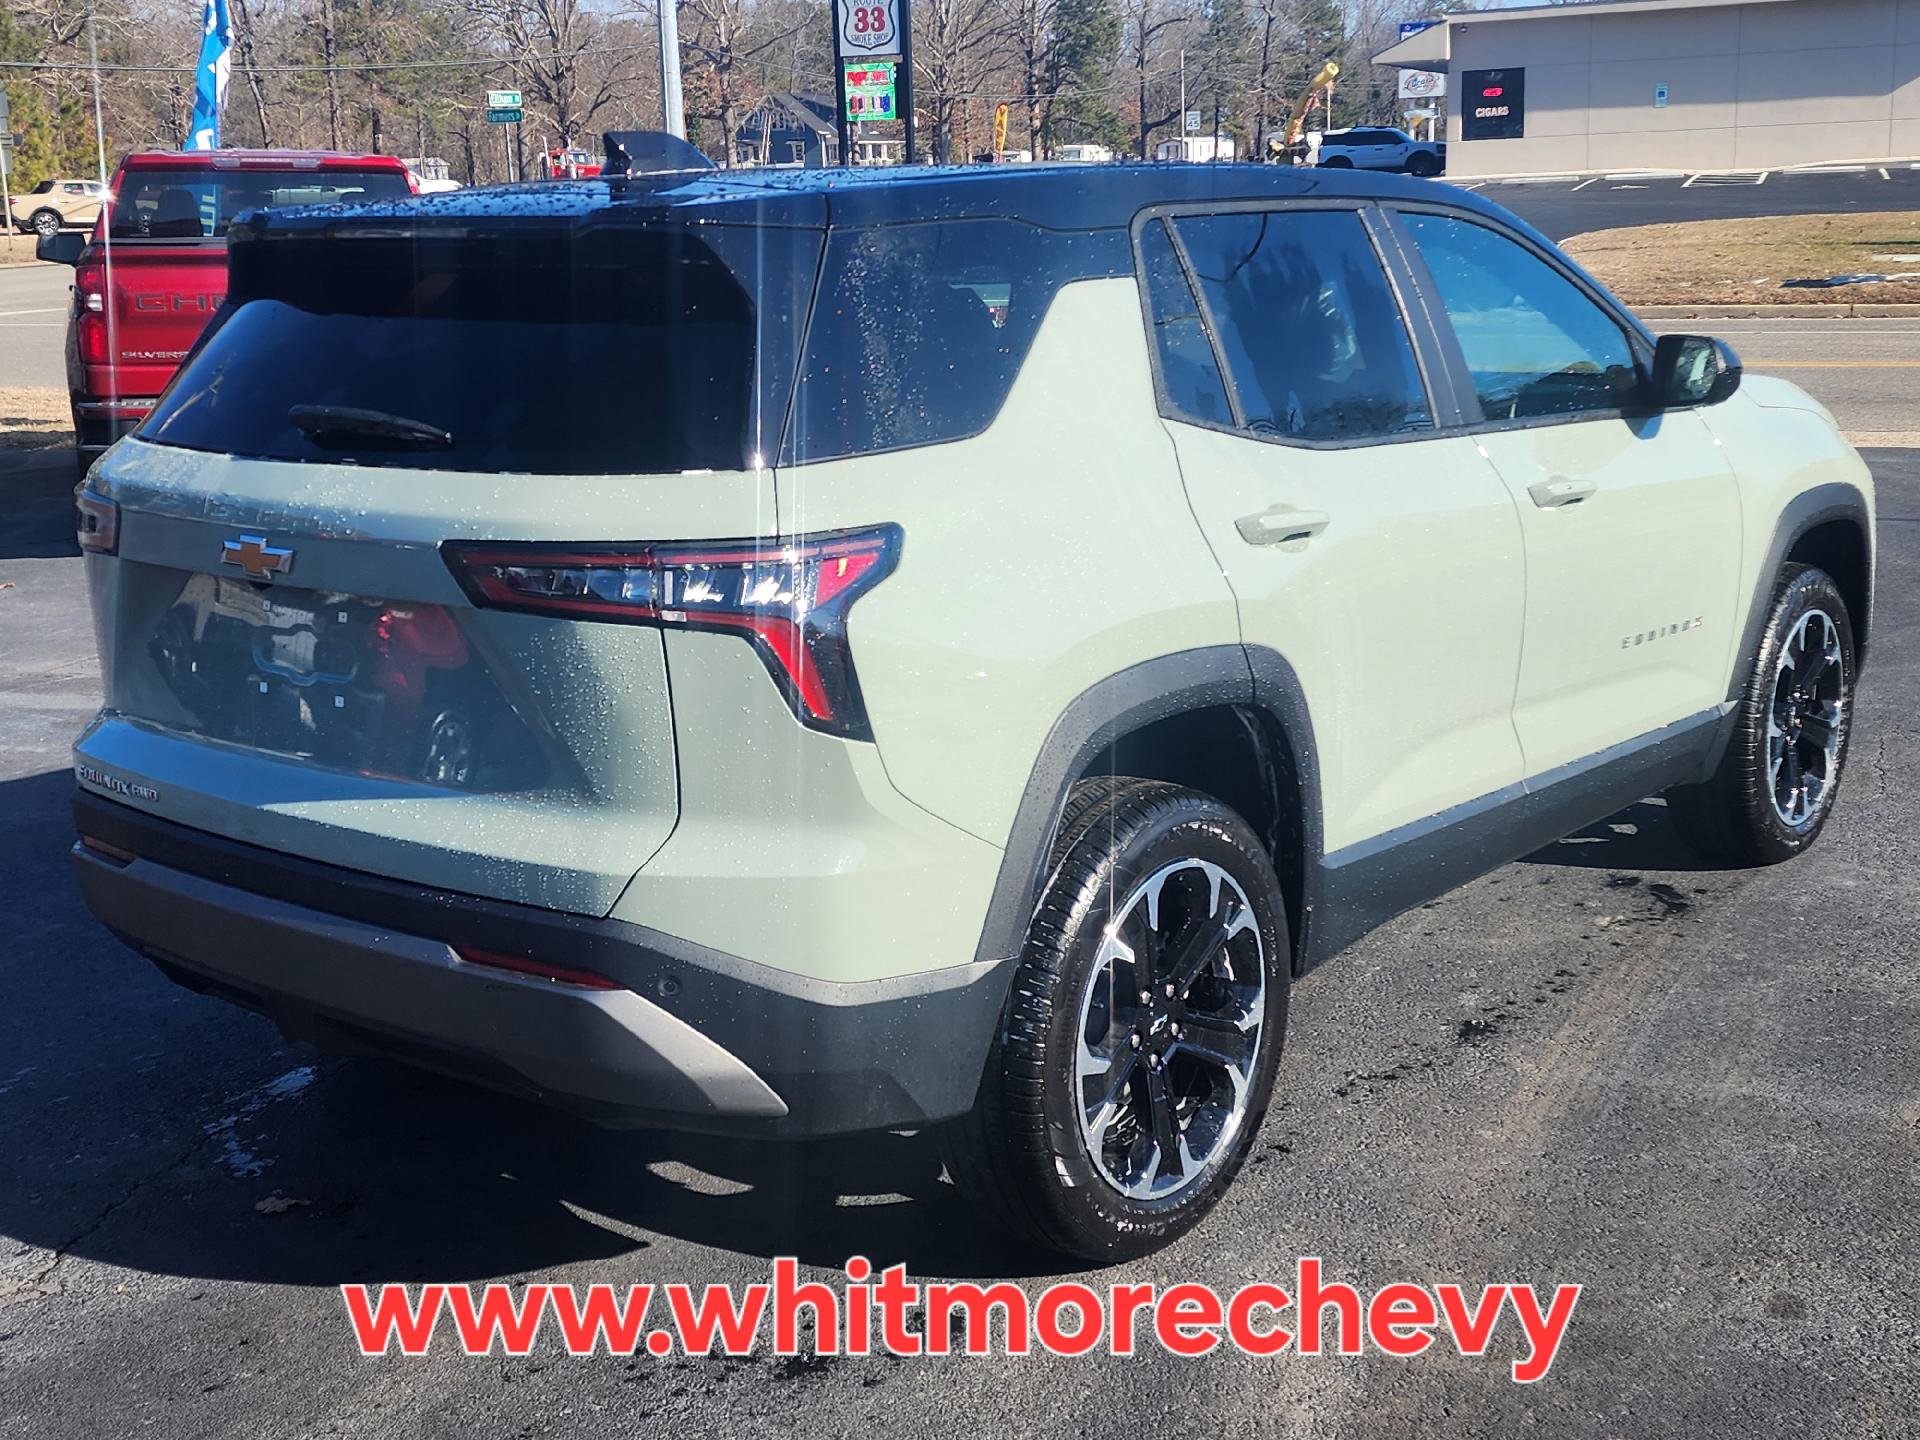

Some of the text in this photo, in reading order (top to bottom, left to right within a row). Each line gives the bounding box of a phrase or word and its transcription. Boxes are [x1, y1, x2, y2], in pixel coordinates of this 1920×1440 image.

[854, 6, 886, 33] 33
[850, 33, 872, 45] SMOKE
[1475, 106, 1510, 118] CIGARS
[1187, 120, 1200, 128] 45
